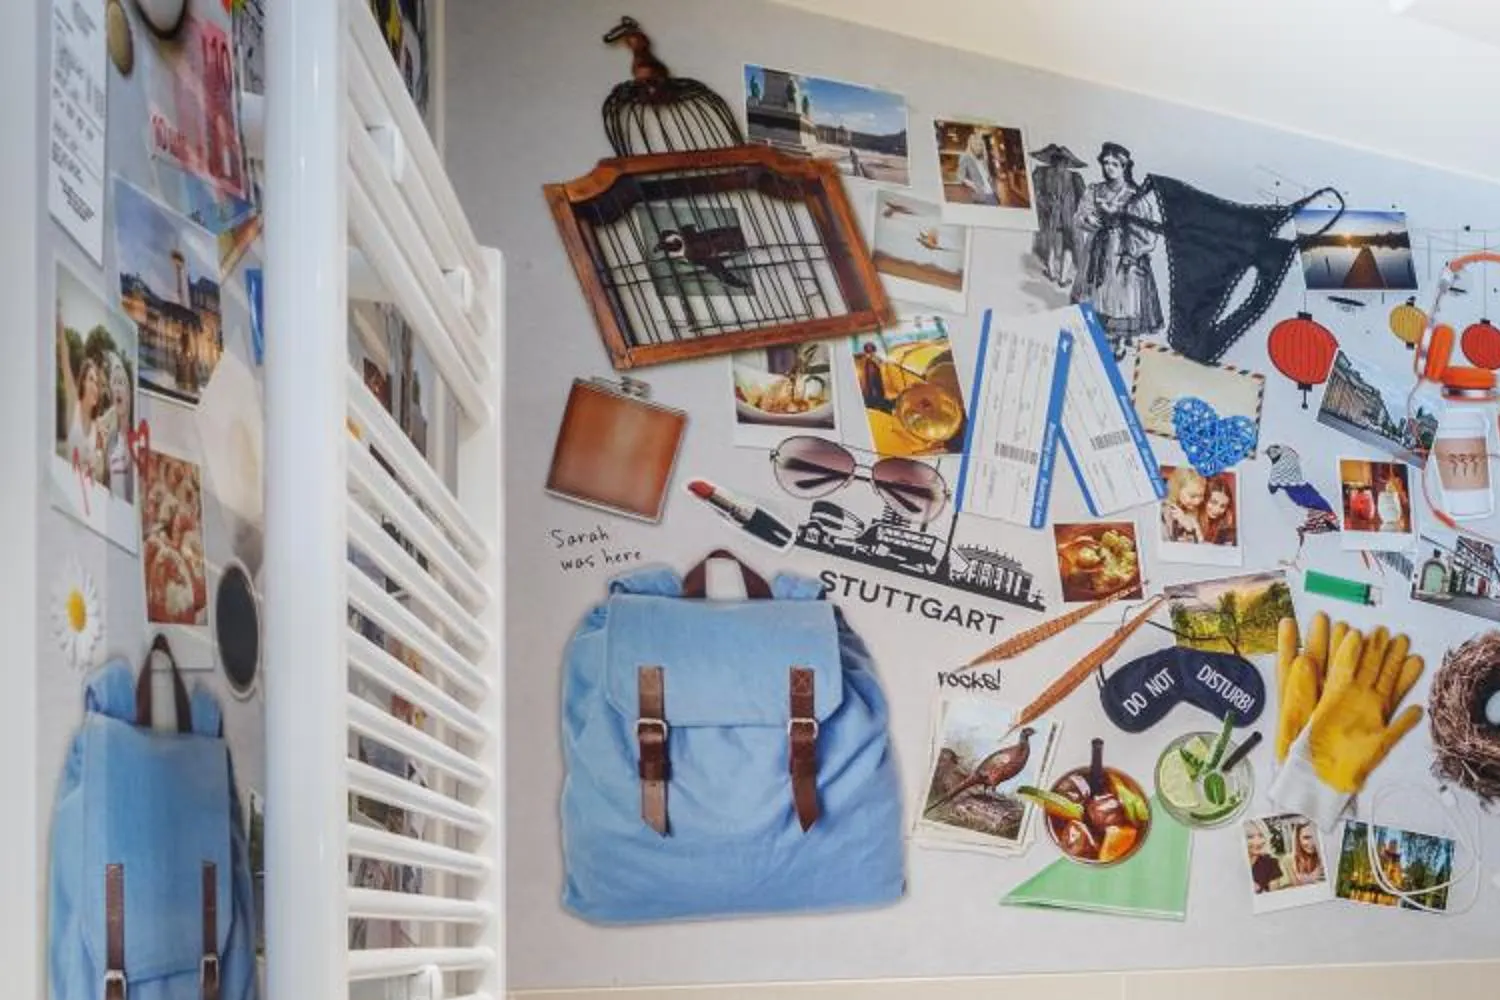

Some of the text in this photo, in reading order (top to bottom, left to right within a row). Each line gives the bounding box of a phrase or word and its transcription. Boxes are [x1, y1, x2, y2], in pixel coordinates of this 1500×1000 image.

[550, 524, 609, 549] Sarah
[561, 547, 641, 571] was here
[819, 570, 1005, 635] STUTTGART
[1123, 691, 1148, 717] DO
[1144, 667, 1175, 698] NOT
